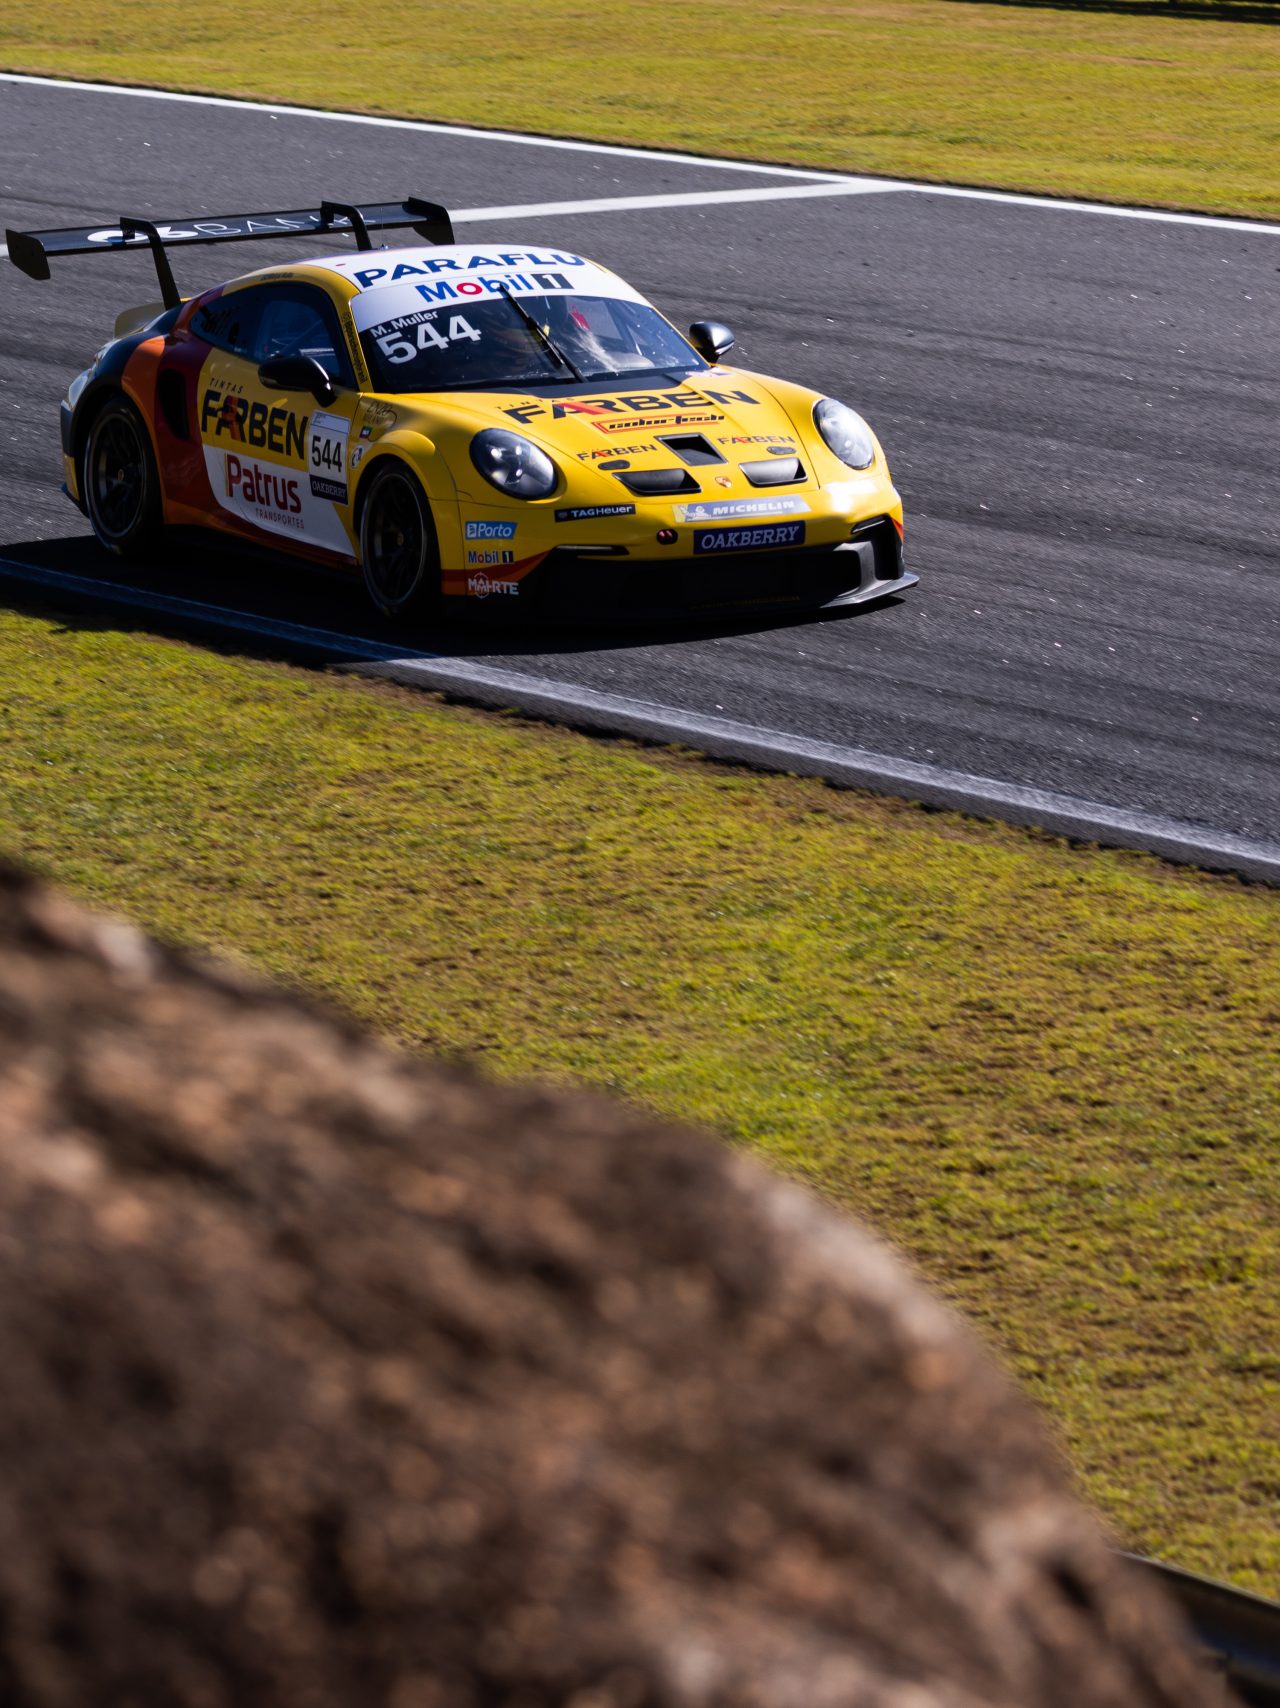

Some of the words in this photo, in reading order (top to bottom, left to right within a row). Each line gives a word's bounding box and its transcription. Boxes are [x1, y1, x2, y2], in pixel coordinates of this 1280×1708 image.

[354, 253, 586, 287] PARAFLU
[415, 273, 533, 303] Mobil
[370, 325, 392, 337] M.
[391, 311, 439, 329] Muller
[376, 315, 482, 364] 544
[209, 378, 243, 394] TINTAS
[502, 389, 761, 424] FARBEN
[201, 389, 308, 459] FARBEN
[576, 444, 658, 460] FARBEN
[716, 435, 795, 444] FARBEN
[311, 435, 342, 473] 544
[226, 453, 301, 513] Patrus
[312, 480, 346, 498] OAKBERRY
[255, 508, 305, 529] TRANSPORTES
[712, 500, 795, 514] MICHELIN
[478, 523, 512, 537] Porto
[701, 525, 800, 550] OAKBERRY
[468, 550, 499, 563] Mobil
